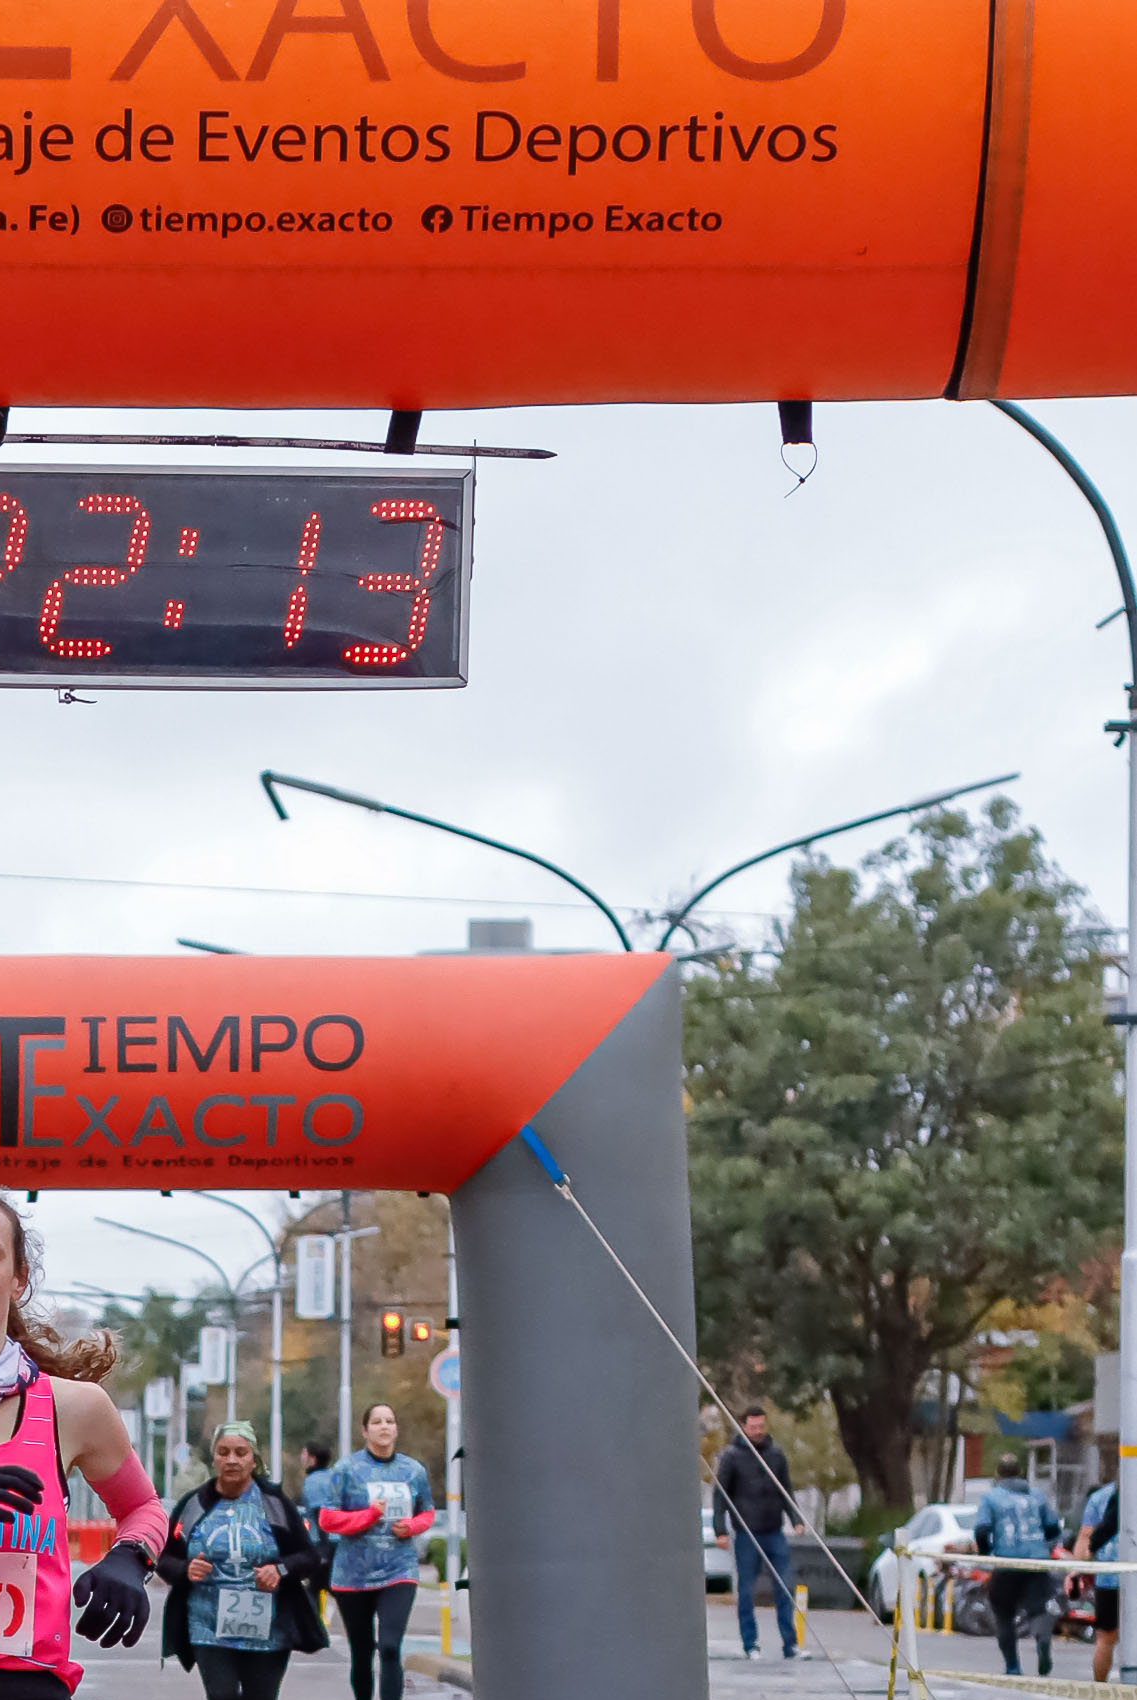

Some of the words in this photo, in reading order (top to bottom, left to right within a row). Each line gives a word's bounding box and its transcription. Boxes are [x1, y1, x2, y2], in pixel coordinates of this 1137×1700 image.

[95, 108, 174, 163] de
[198, 111, 451, 163] Eventos
[475, 110, 838, 177] Deportivos
[29, 204, 80, 236] Fe)
[139, 204, 393, 239] tiempo.exacto
[460, 204, 594, 239] Tiempo
[604, 204, 723, 233] Exacto
[77, 1154, 108, 1169] de
[122, 1154, 215, 1169] Eventos
[227, 1154, 355, 1171] Deportivos
